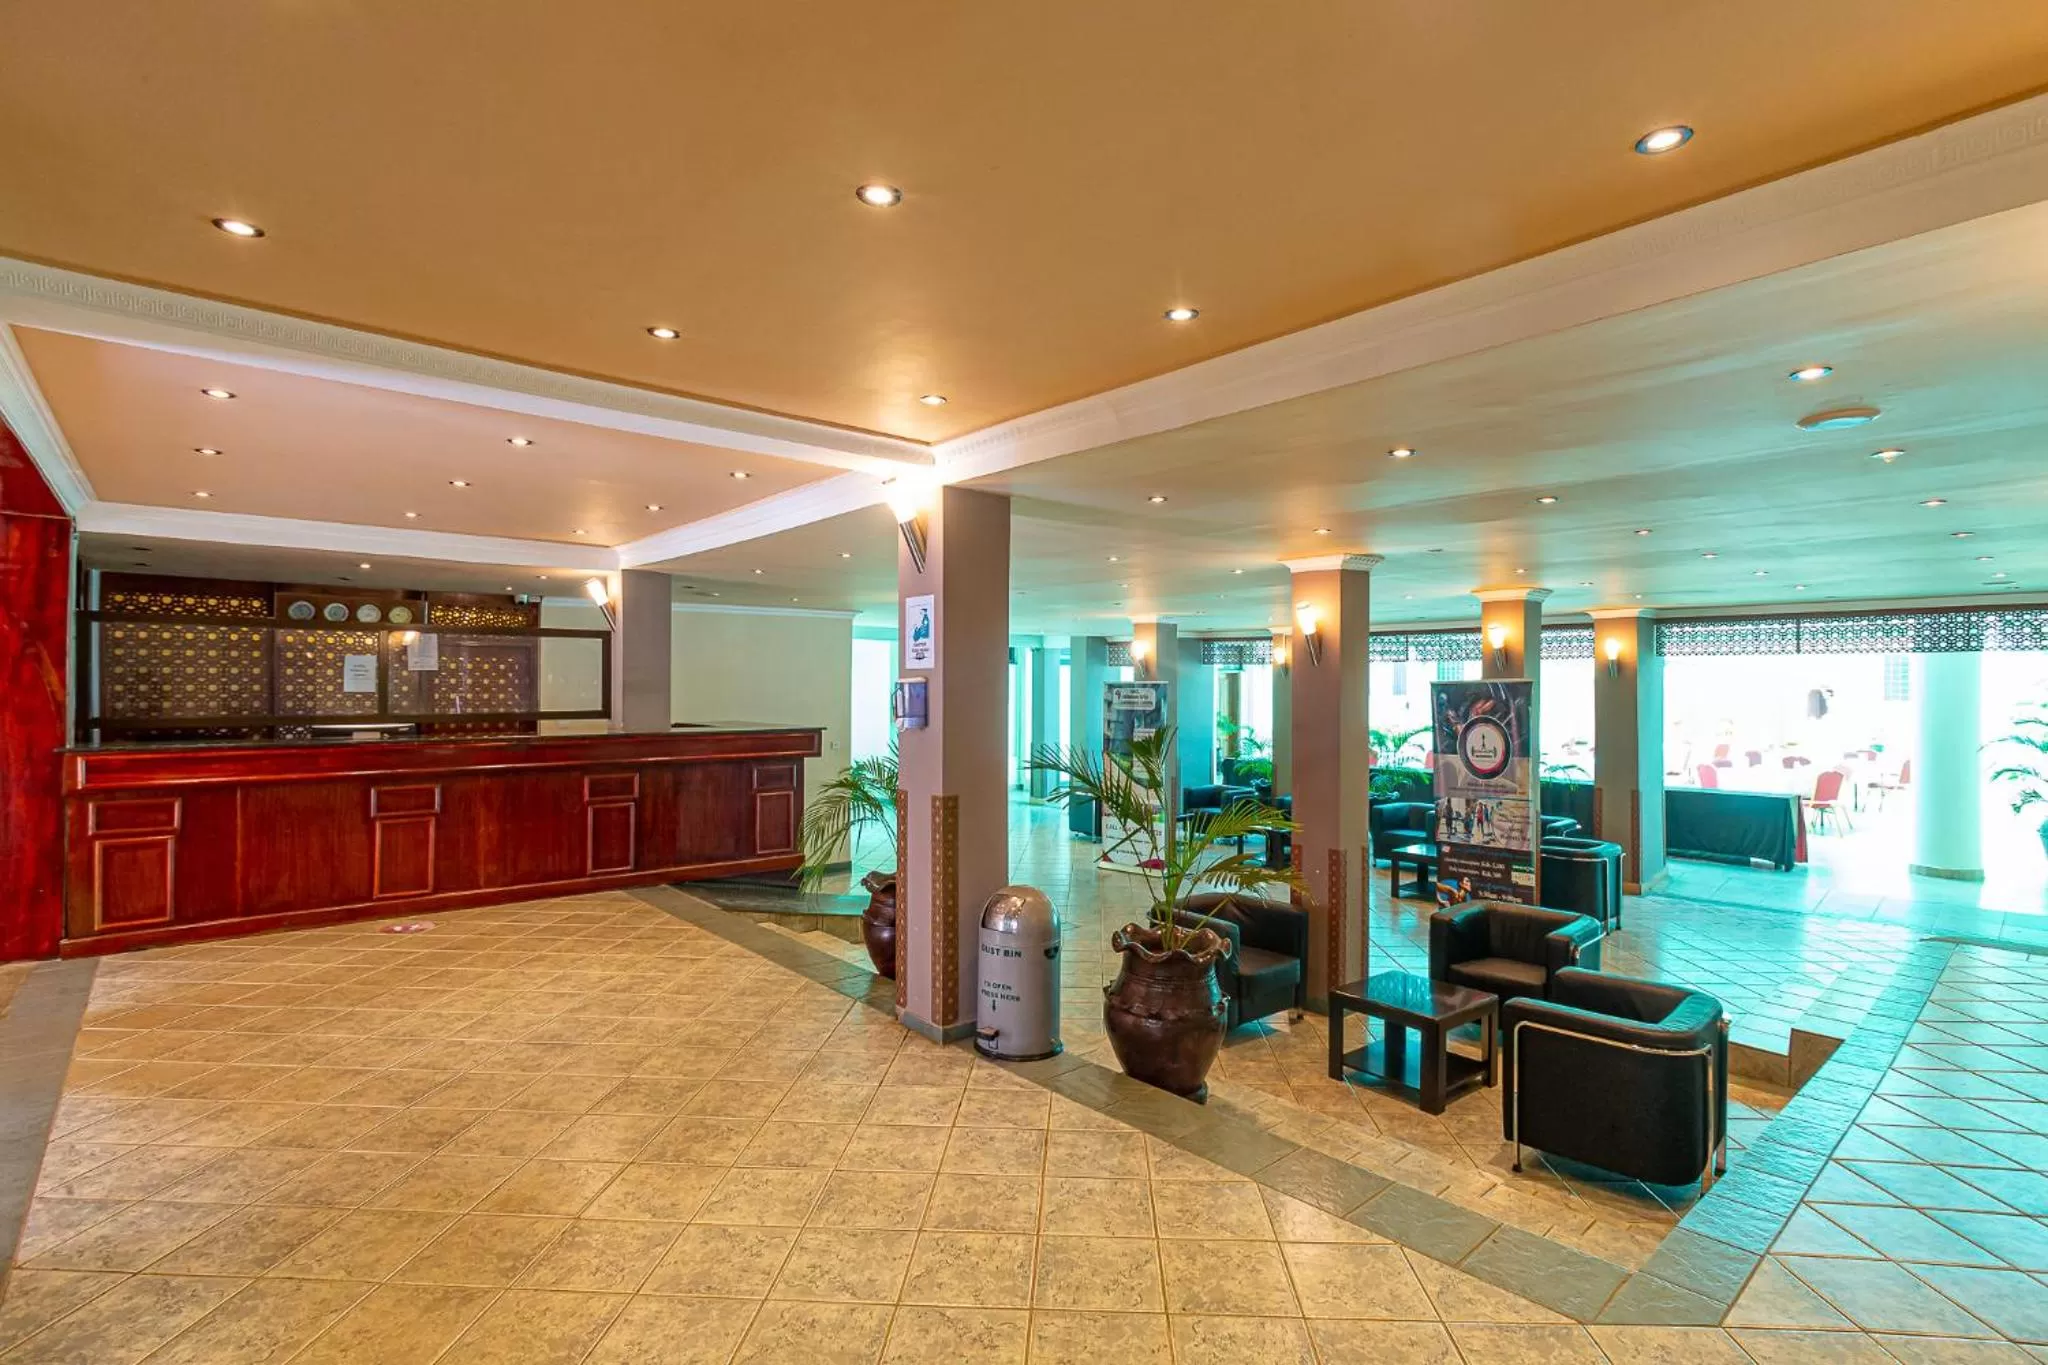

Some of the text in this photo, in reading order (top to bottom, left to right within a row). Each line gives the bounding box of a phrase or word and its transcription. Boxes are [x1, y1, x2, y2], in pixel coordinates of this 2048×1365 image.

[981, 943, 1022, 958] DUST BIN
[992, 982, 1012, 990] OPEN
[981, 988, 1021, 1002] PRESS HERE
